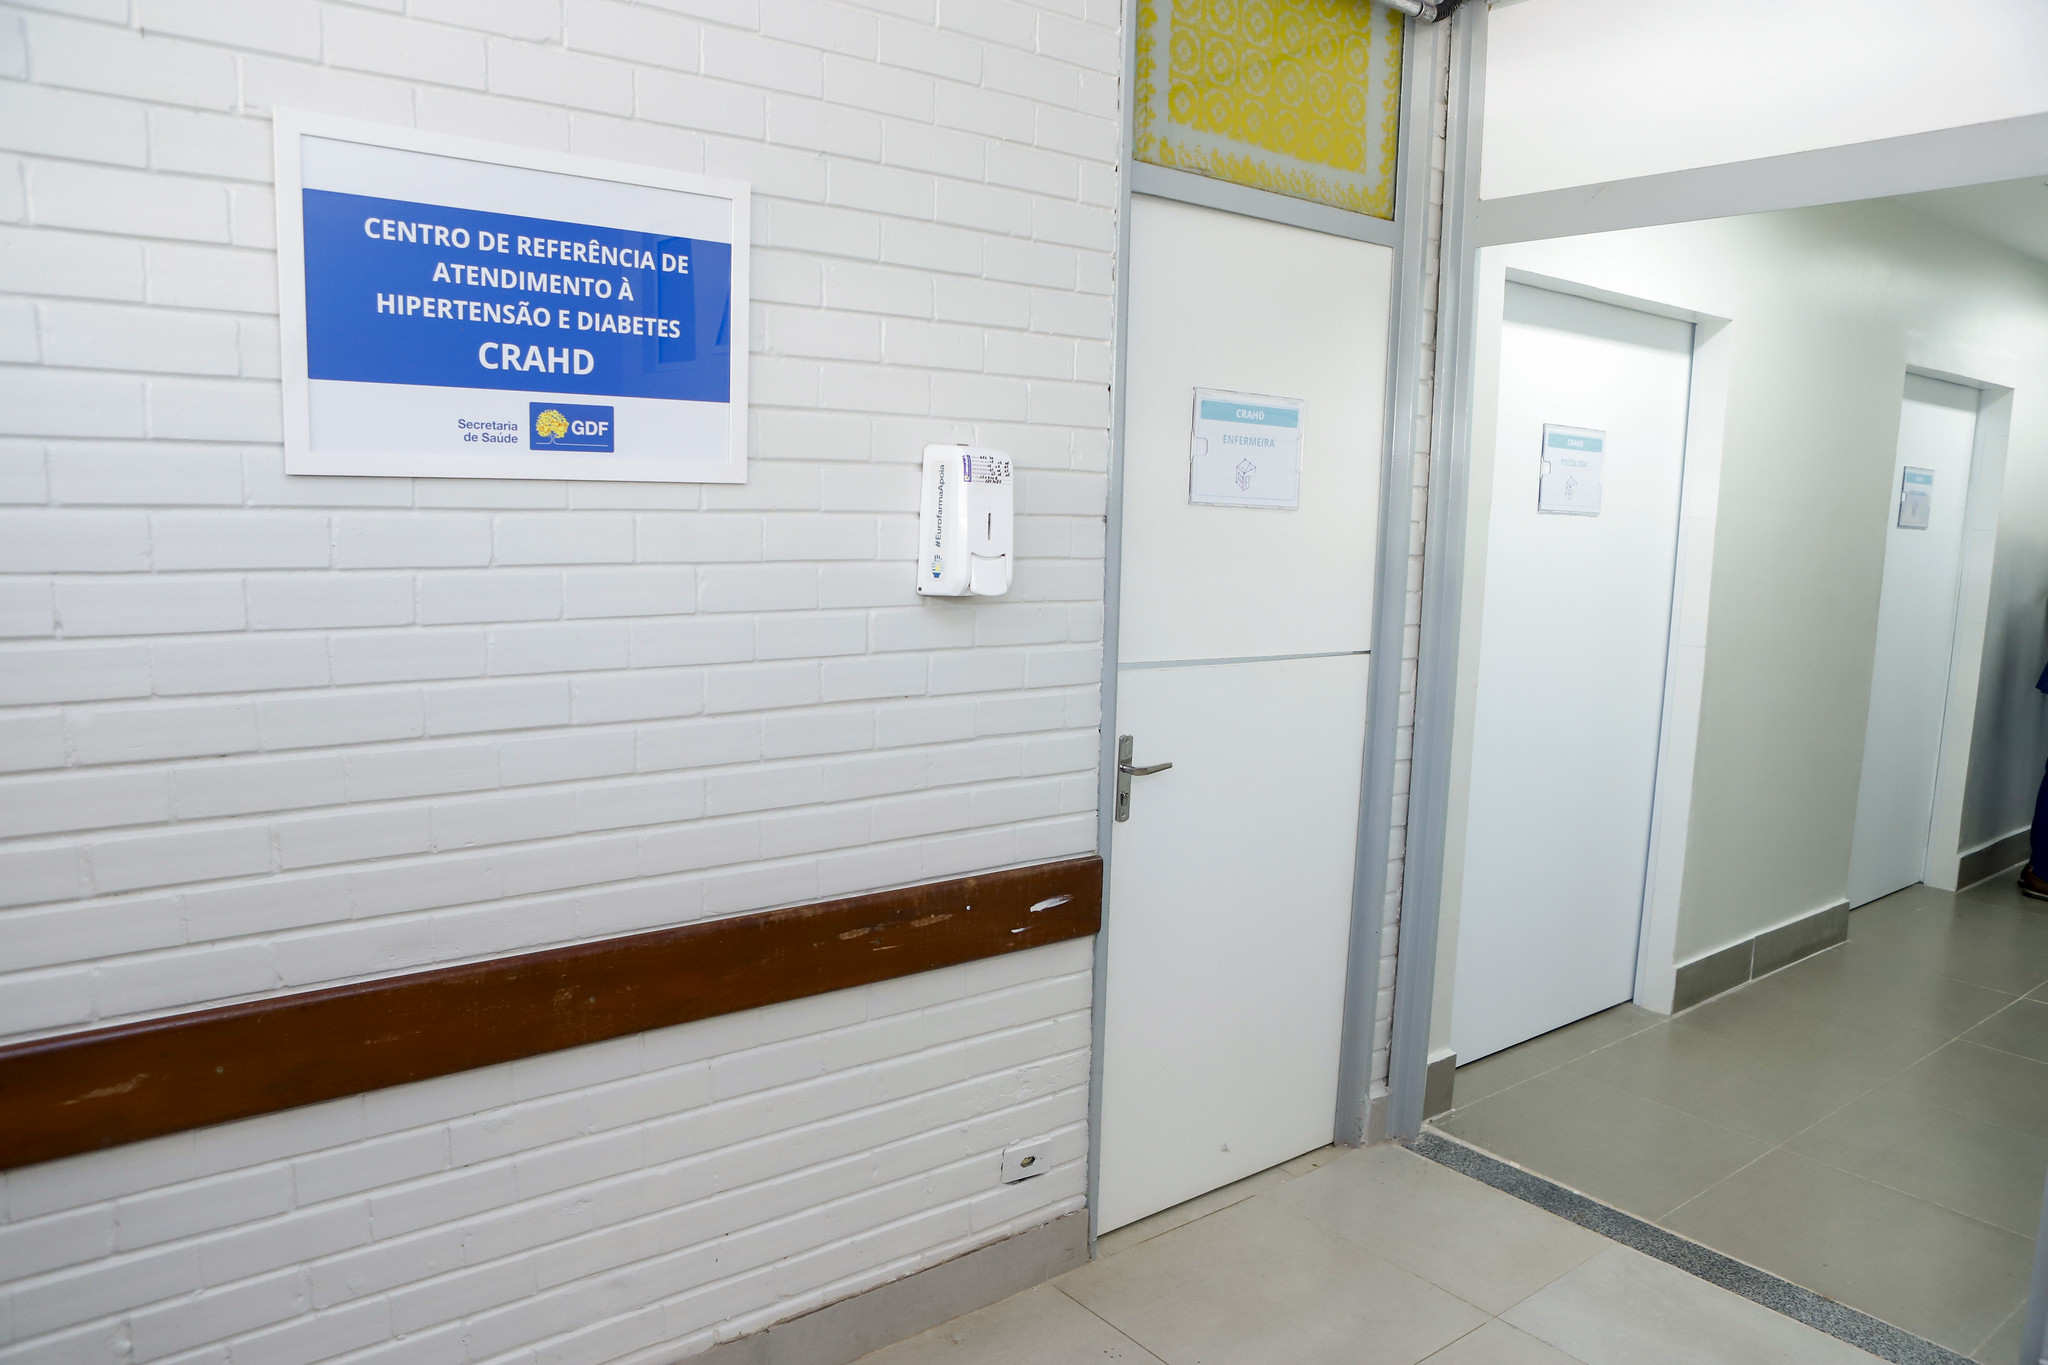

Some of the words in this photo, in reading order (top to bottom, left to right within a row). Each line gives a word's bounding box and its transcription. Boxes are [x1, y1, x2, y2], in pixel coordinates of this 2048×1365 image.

[364, 217, 470, 249] CENTRO
[478, 231, 509, 254] DE
[517, 235, 656, 271] REFERÊNCIA
[662, 253, 689, 275] DE
[432, 262, 612, 299] ATENDIMENTO
[618, 276, 634, 302] À
[376, 292, 551, 328] HIPERTENSÃO
[558, 309, 570, 329] E
[577, 311, 681, 339] DIABETES
[478, 341, 595, 376] CRAHD
[457, 418, 518, 431] Secretaria
[1235, 408, 1265, 421] CRAHD
[463, 432, 479, 443] de
[481, 432, 519, 444] Saúde
[571, 420, 609, 437] GDF
[1223, 434, 1275, 448] ENFERMEIRA
[935, 465, 945, 547] #EurofarmaApoia
